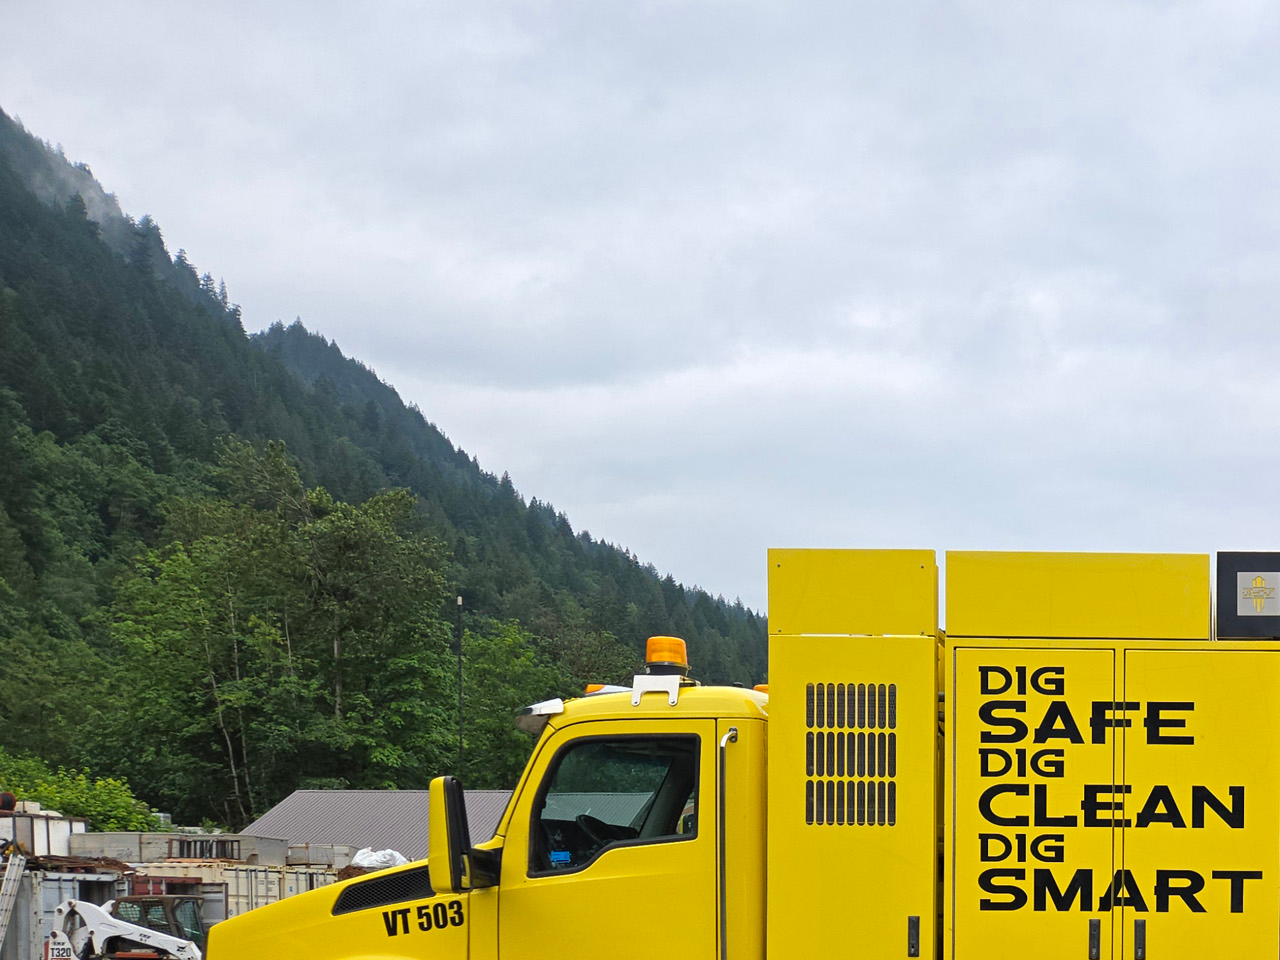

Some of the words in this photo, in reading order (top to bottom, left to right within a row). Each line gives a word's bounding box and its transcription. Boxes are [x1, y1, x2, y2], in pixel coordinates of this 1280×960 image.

[978, 665, 1065, 696] DIG
[978, 700, 1195, 745] SAFE
[978, 748, 1065, 778] DIG
[978, 783, 1245, 829] CLEAN
[978, 833, 1065, 863] DIG
[978, 868, 1263, 914] SMART
[382, 908, 411, 937] VT
[416, 900, 465, 932] 503
[50, 947, 71, 958] T320
